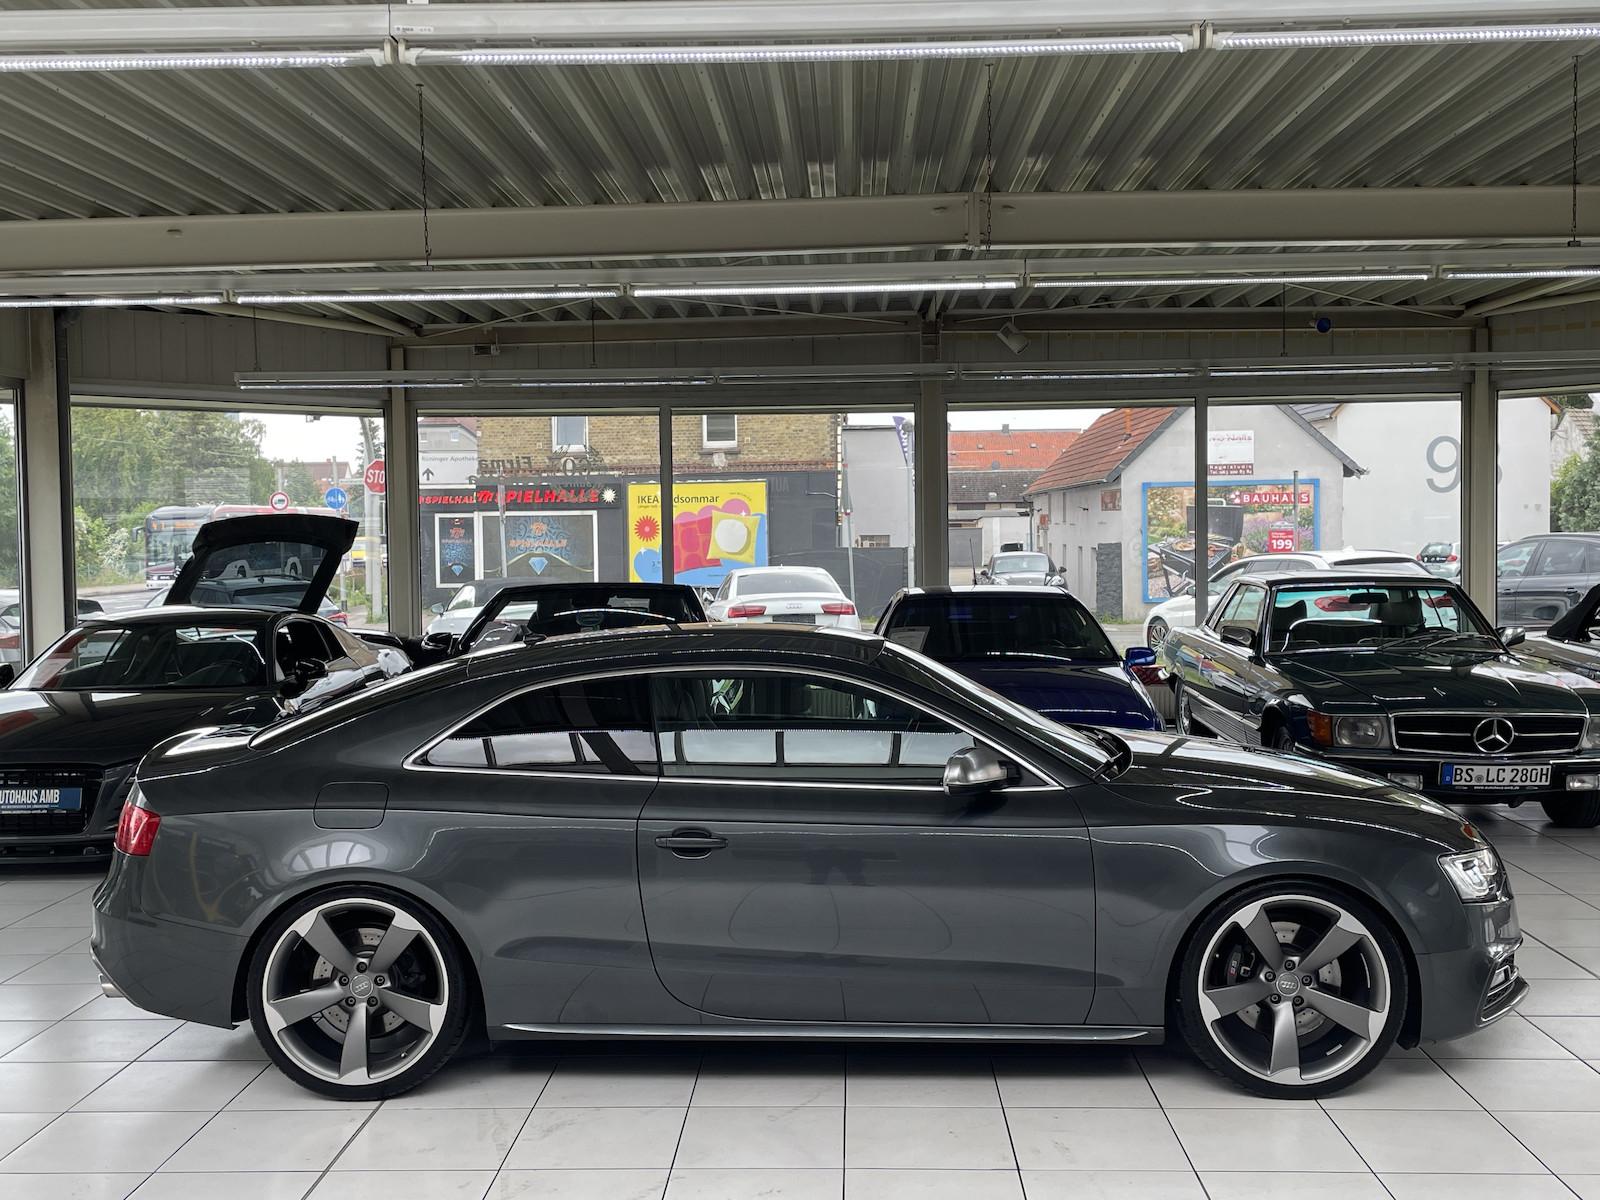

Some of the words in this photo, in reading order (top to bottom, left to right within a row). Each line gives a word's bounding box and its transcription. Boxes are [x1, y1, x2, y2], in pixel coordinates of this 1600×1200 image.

[367, 470, 385, 484] STO
[425, 495, 476, 503] SPIELHAL
[637, 495, 659, 504] IKEA
[673, 493, 720, 504] dsommar
[1454, 767, 1475, 783] BS
[1485, 767, 1506, 783] LC
[1509, 767, 1550, 783] 280H
[0, 789, 39, 804] UTOHAUS
[39, 789, 60, 803] AMB
